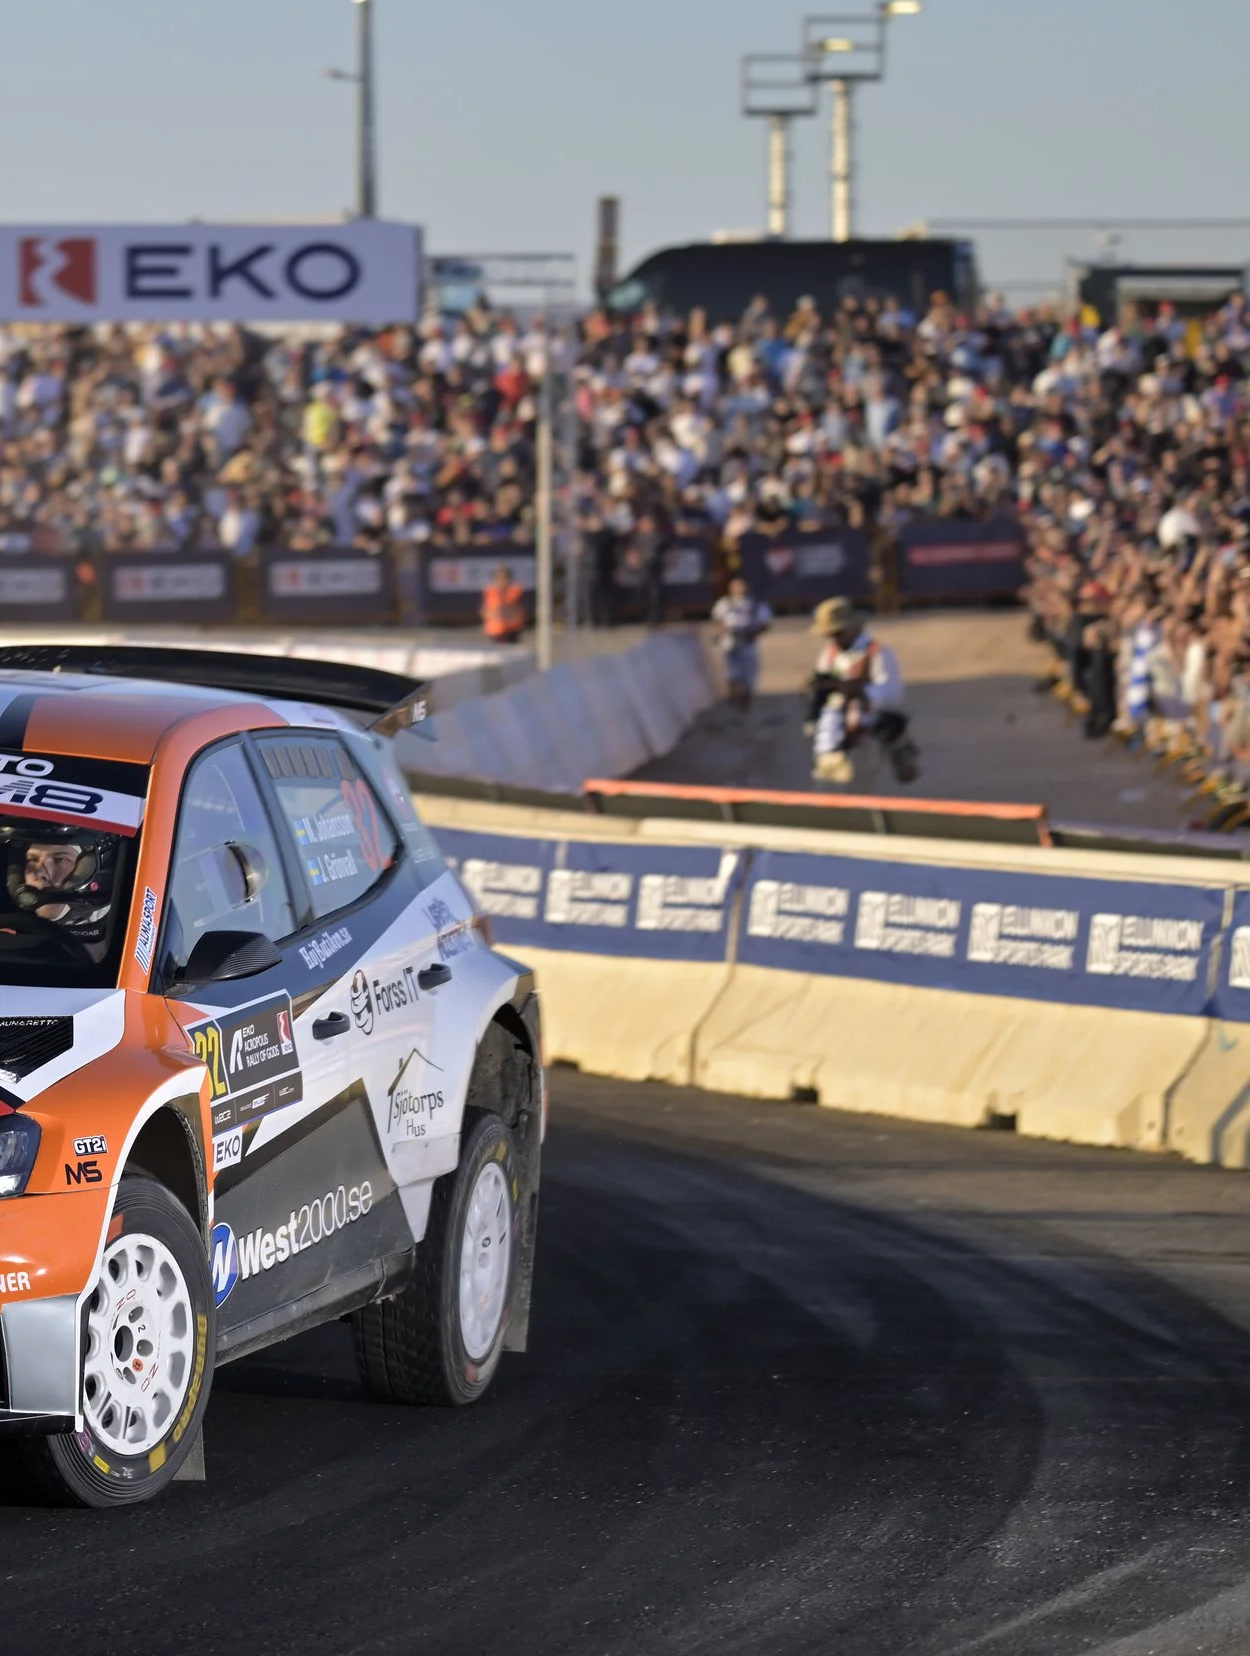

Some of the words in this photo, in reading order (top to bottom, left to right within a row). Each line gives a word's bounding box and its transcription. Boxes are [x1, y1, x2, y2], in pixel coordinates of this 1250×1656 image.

[125, 242, 362, 301] EKO
[140, 886, 157, 949] ALMASPORT
[373, 979, 407, 1015] Forss
[403, 966, 419, 1003] IT
[242, 1024, 255, 1037] EKO
[244, 1033, 269, 1053] ACROPOLIS
[246, 1051, 260, 1067] RALLY
[265, 1044, 280, 1060] GODS
[406, 1118, 426, 1137] Hus
[73, 1136, 107, 1155] GT2i
[216, 1135, 241, 1163] EKO
[238, 1181, 373, 1281] West2000.se
